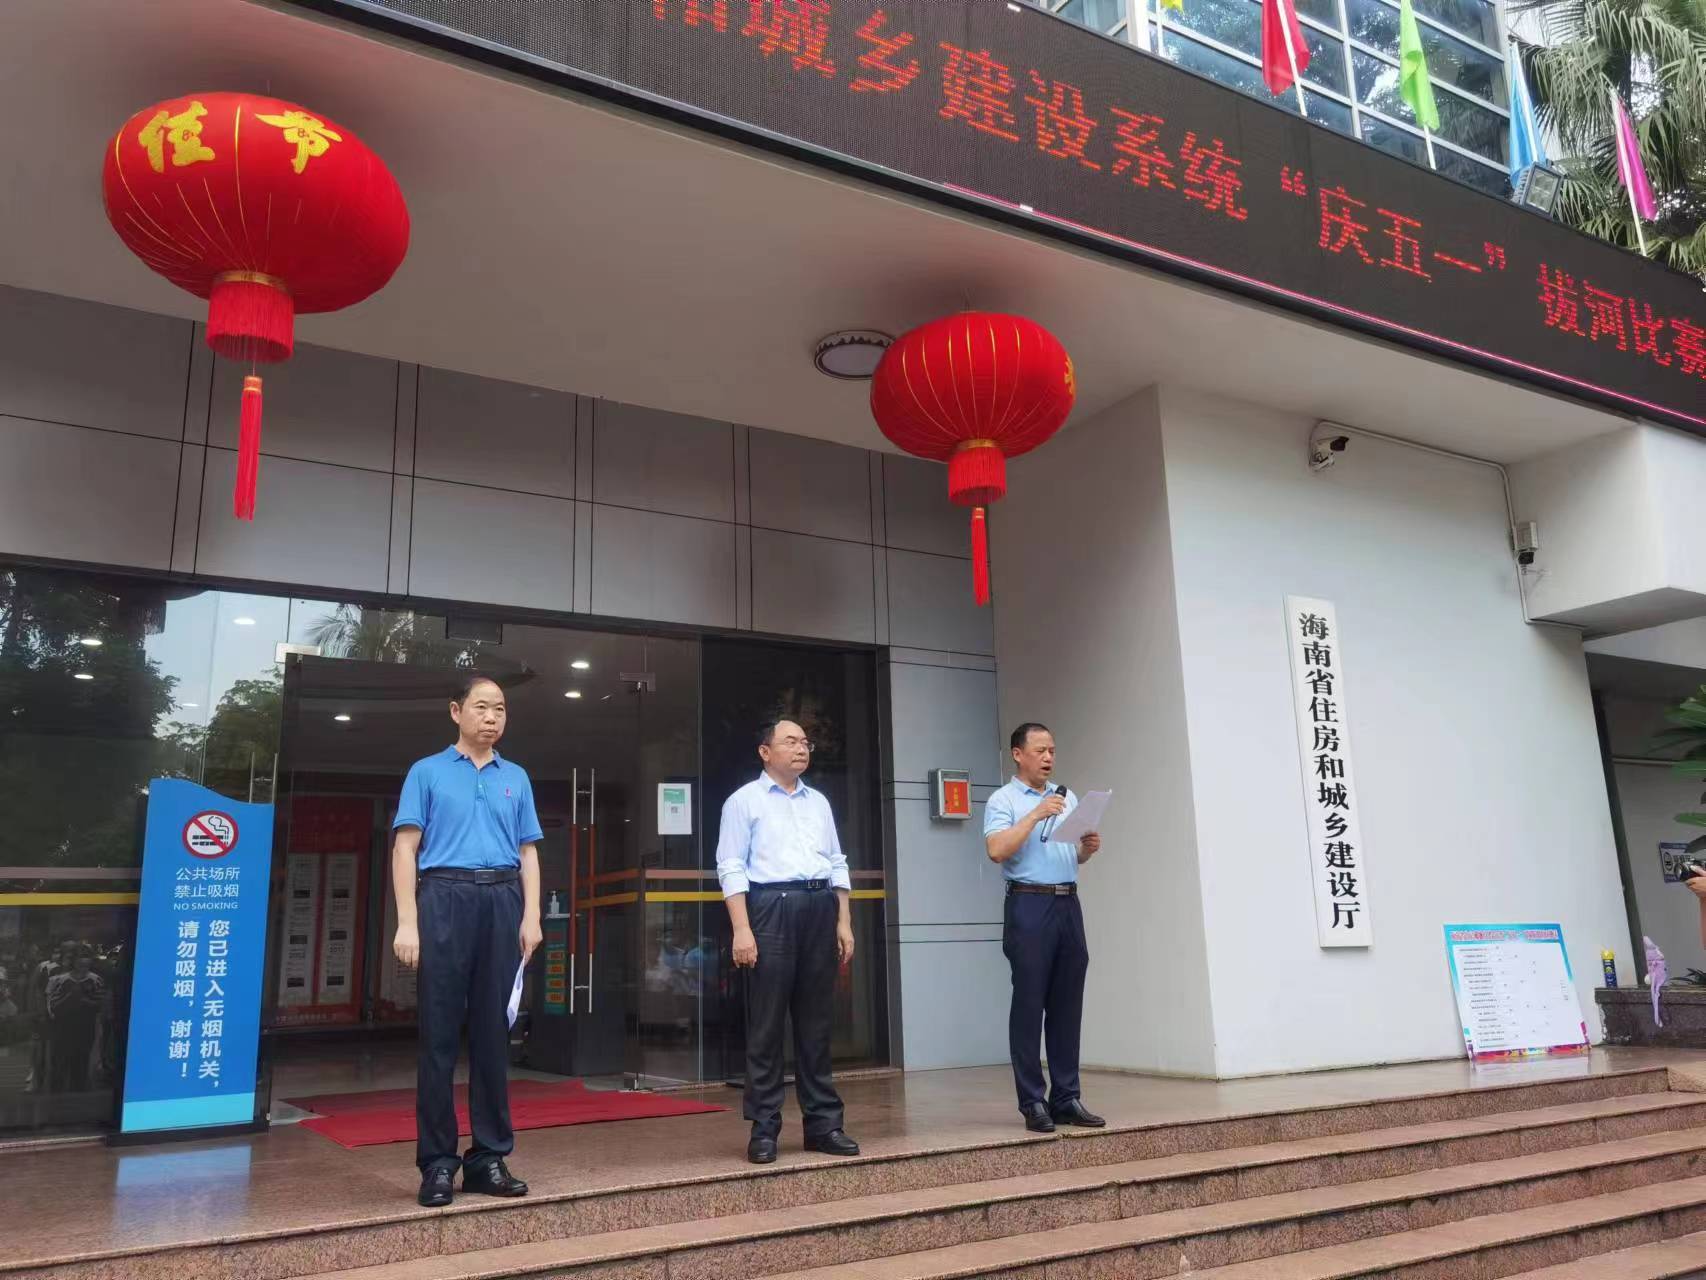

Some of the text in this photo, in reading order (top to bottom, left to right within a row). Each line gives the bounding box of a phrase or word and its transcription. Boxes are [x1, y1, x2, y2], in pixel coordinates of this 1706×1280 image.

[1299, 612, 1360, 929] 海南省住房和城乡建设厅
[176, 866, 240, 880] 公共场所
[174, 884, 239, 898] 禁止吸烟
[173, 901, 239, 910] NO SMOKING
